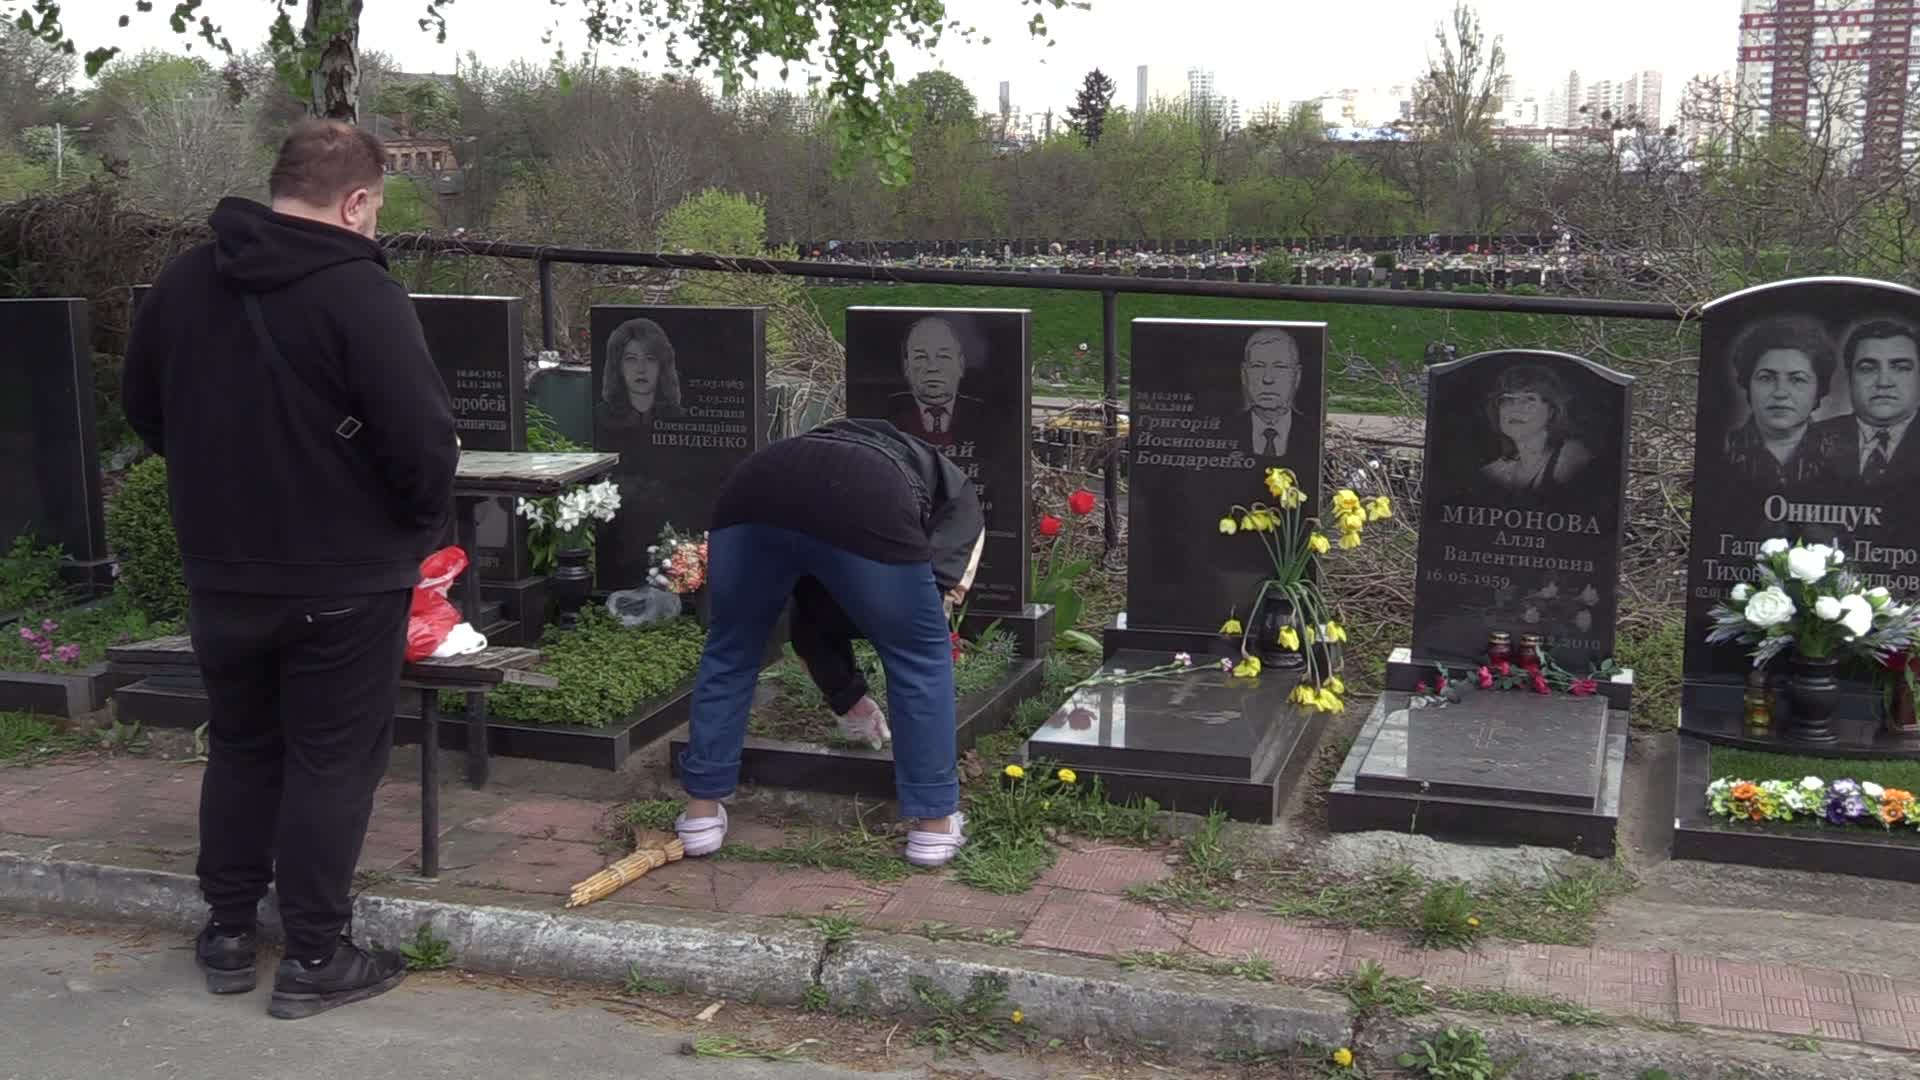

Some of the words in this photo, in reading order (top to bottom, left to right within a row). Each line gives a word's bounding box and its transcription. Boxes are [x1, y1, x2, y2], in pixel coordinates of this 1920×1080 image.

[451, 393, 506, 415] оробей
[689, 406, 745, 419] Світлана
[1137, 415, 1221, 432] Григорій
[652, 432, 748, 449] ШВИДЕНКО
[1136, 432, 1240, 450] Йосипович
[1136, 450, 1257, 472] Бондаренко
[1442, 504, 1601, 535] МИРОНОВА
[1764, 494, 1883, 531] Онищук
[1493, 531, 1546, 549] Алла
[1719, 534, 1761, 556] Гал
[1443, 545, 1594, 573] Валентиновна
[1853, 540, 1917, 570] Петро
[1703, 558, 1765, 583] Тихов
